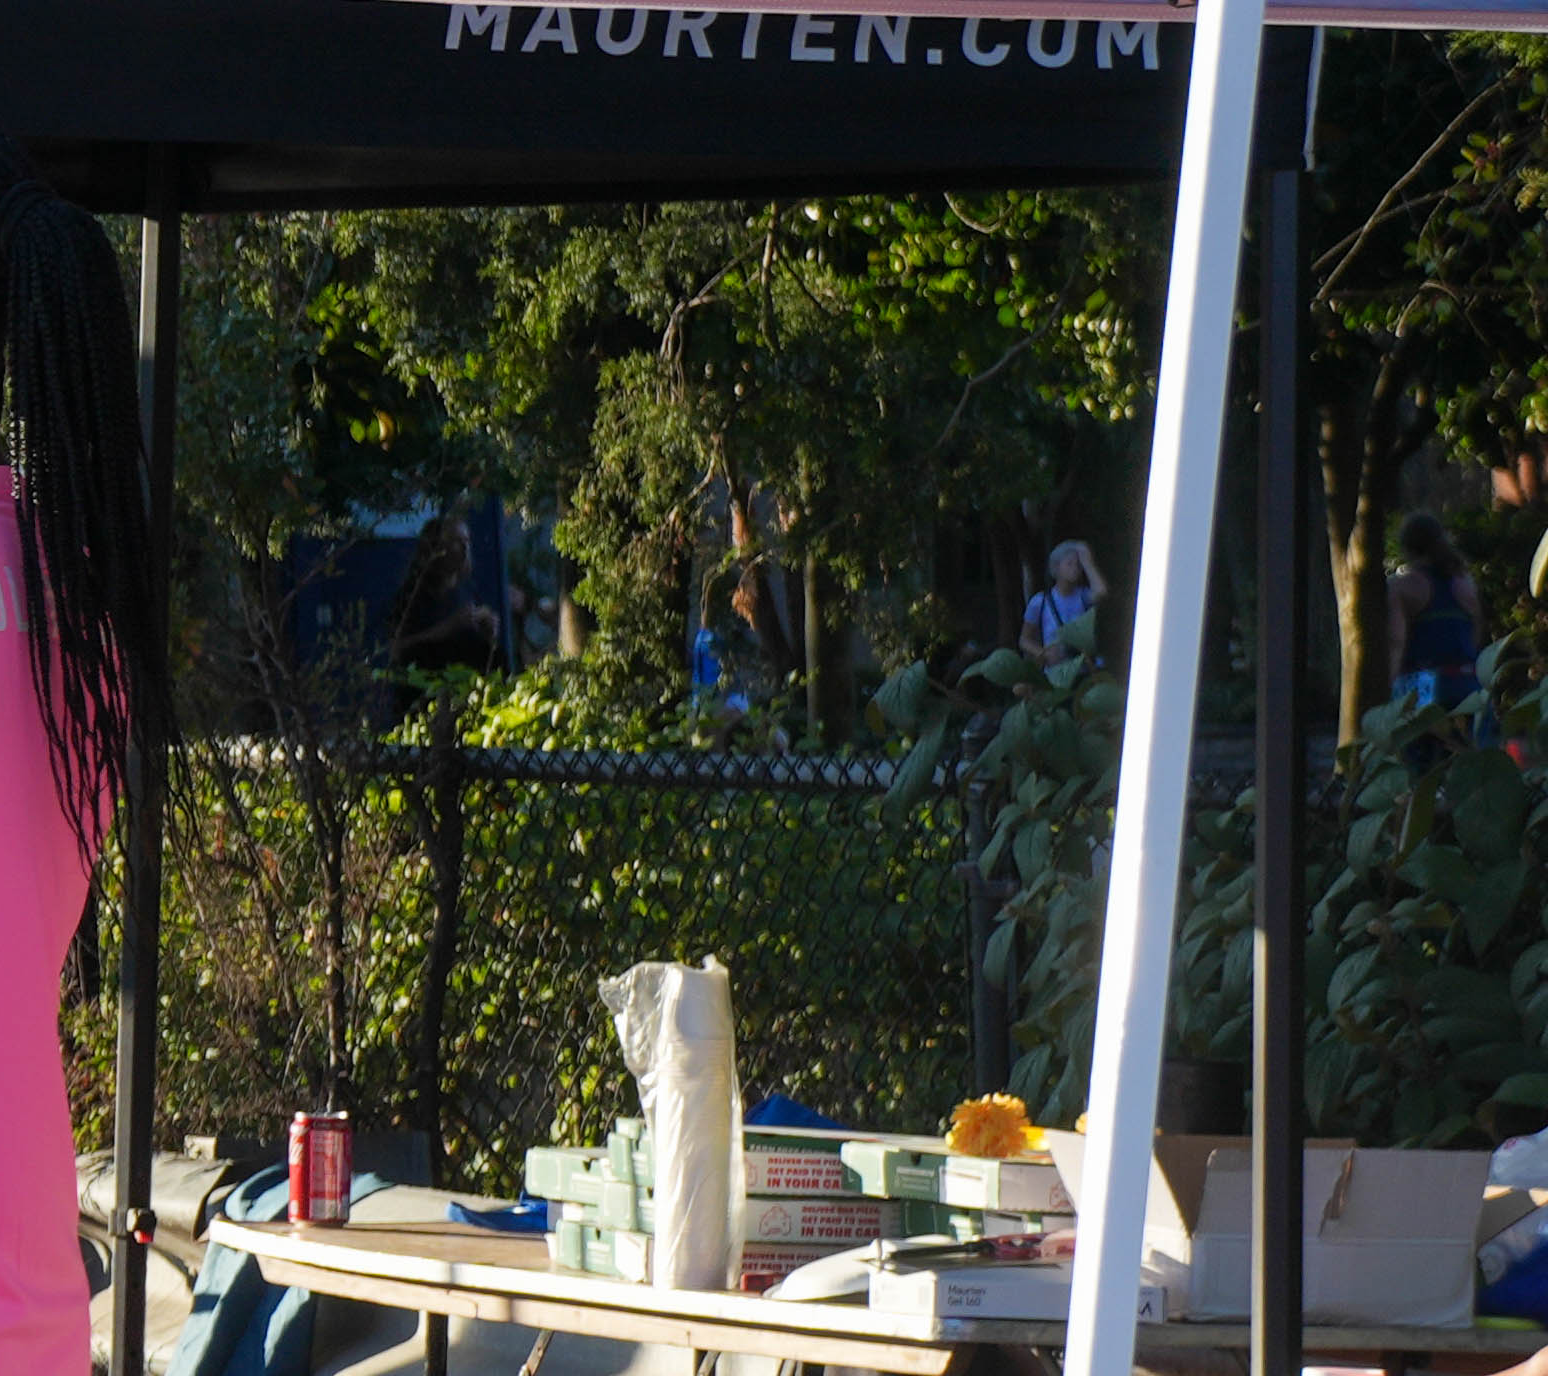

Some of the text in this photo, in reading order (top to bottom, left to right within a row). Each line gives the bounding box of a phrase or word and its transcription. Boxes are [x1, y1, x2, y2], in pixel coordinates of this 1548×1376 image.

[768, 1156, 801, 1165] DELIVER
[767, 1167, 784, 1175] GET
[786, 1168, 809, 1176] PAID
[766, 1177, 780, 1187] IN
[784, 1178, 820, 1189] YOUR
[800, 1227, 881, 1237] IN YOUR CAR
[948, 1296, 963, 1306] Gel
